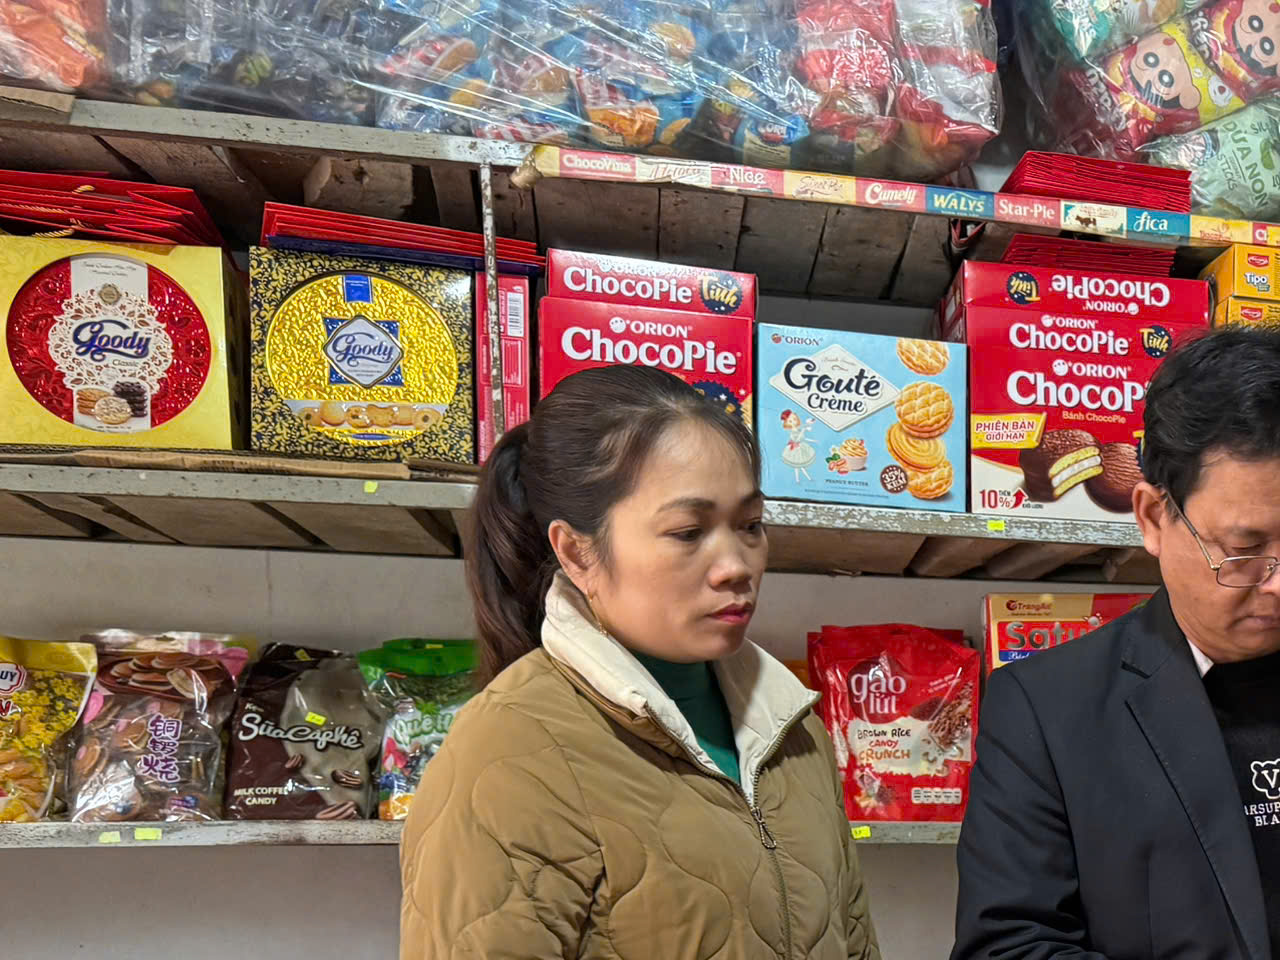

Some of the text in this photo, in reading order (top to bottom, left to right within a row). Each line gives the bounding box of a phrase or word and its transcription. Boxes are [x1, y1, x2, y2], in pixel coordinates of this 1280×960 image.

[1246, 160, 1268, 207] NON
[934, 194, 985, 212] WALYS
[999, 199, 1056, 219] Star-Pie
[563, 266, 693, 303] ChocoPie
[1052, 274, 1170, 308] ChocoPie
[1085, 301, 1126, 314] ORION
[630, 321, 688, 338] ORION
[1053, 317, 1097, 329] ORION
[73, 320, 152, 362] Goody
[332, 333, 395, 364] Goody
[1009, 323, 1129, 355] ChocoPie
[561, 326, 737, 375] ChocoPie
[784, 358, 881, 397] Gouté
[1072, 362, 1128, 379] ORION
[1007, 371, 1150, 412] ChocoP
[807, 393, 865, 413] Crème
[975, 420, 1010, 433] PHIÊN
[1062, 410, 1127, 424] Bánh ChocoPie
[857, 728, 888, 739] BROWN
[869, 739, 899, 750] CANDY
[858, 749, 911, 761] CRUNCH
[1261, 769, 1280, 789] V
[245, 796, 278, 806] CANDY
